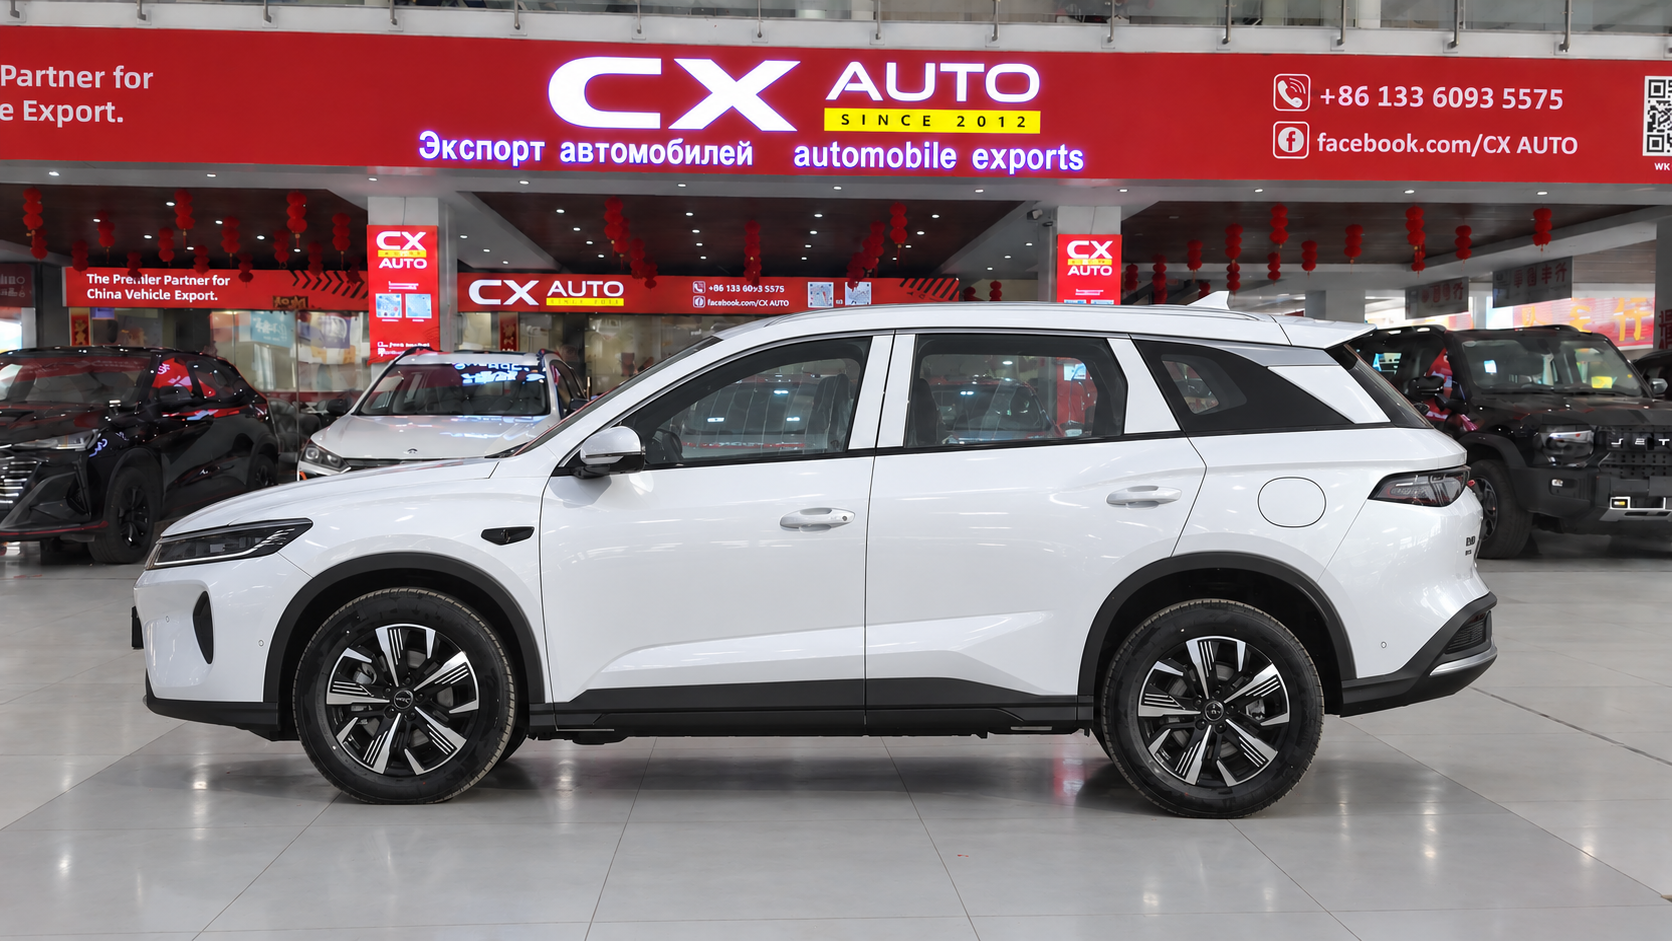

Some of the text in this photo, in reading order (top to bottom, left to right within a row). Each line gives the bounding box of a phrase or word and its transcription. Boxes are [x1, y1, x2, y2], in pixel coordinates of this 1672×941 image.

[1, 65, 153, 89] Partner for
[549, 57, 1039, 131] CX AUTO
[1321, 85, 1563, 109] +86 133 6093 5575
[23, 100, 123, 127] Export.
[842, 114, 1026, 128] SINCE 2012
[418, 131, 753, 167] Экспорт автомобилей
[1317, 133, 1578, 158] facebook.com/CX AUTO
[794, 141, 1084, 174] automobile exports
[376, 230, 427, 251] CX
[1067, 240, 1113, 259] CX
[379, 257, 427, 269] AUTO
[1067, 265, 1112, 276] AUTO
[86, 273, 110, 284] The
[164, 275, 210, 286] Partner
[212, 275, 231, 286] for
[708, 284, 724, 292] +86
[726, 284, 741, 292] 133
[87, 288, 218, 303] China Vehicle Export.
[469, 280, 624, 305] CX AUTO
[769, 299, 790, 307] AUTO
